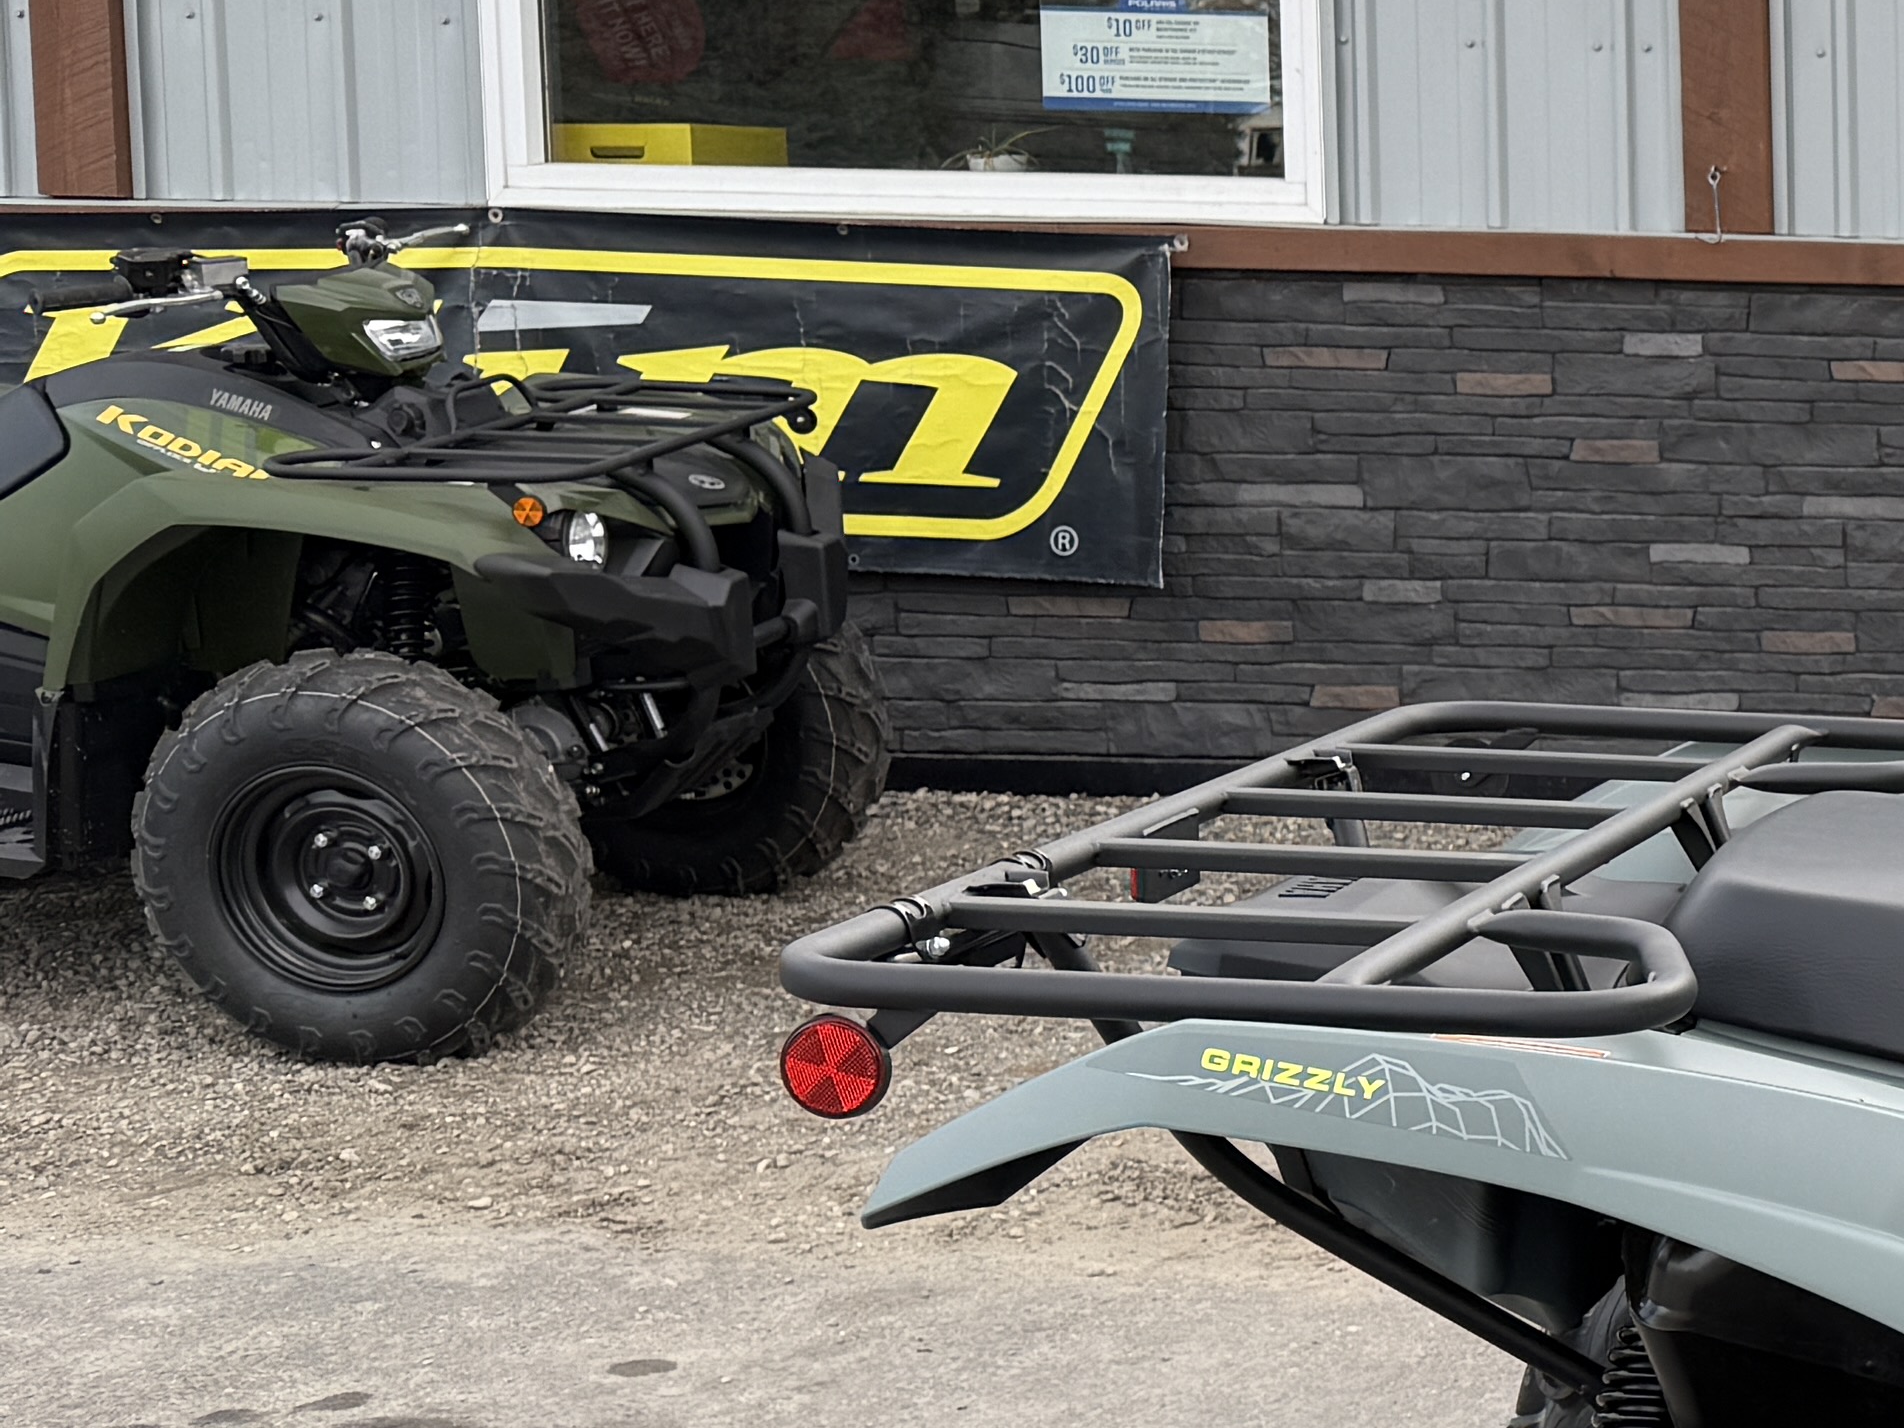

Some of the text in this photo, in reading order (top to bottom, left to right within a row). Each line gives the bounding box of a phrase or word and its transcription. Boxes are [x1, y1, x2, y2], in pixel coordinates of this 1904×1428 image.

[1107, 17, 1132, 37] $10
[1135, 19, 1152, 31] OFF
[1073, 44, 1100, 65] $30
[1103, 47, 1120, 58] OFF
[1060, 73, 1096, 93] $100
[1099, 75, 1115, 87] OFF
[210, 389, 273, 421] YAMAHA
[1201, 1047, 1385, 1100] GRIZZLY
